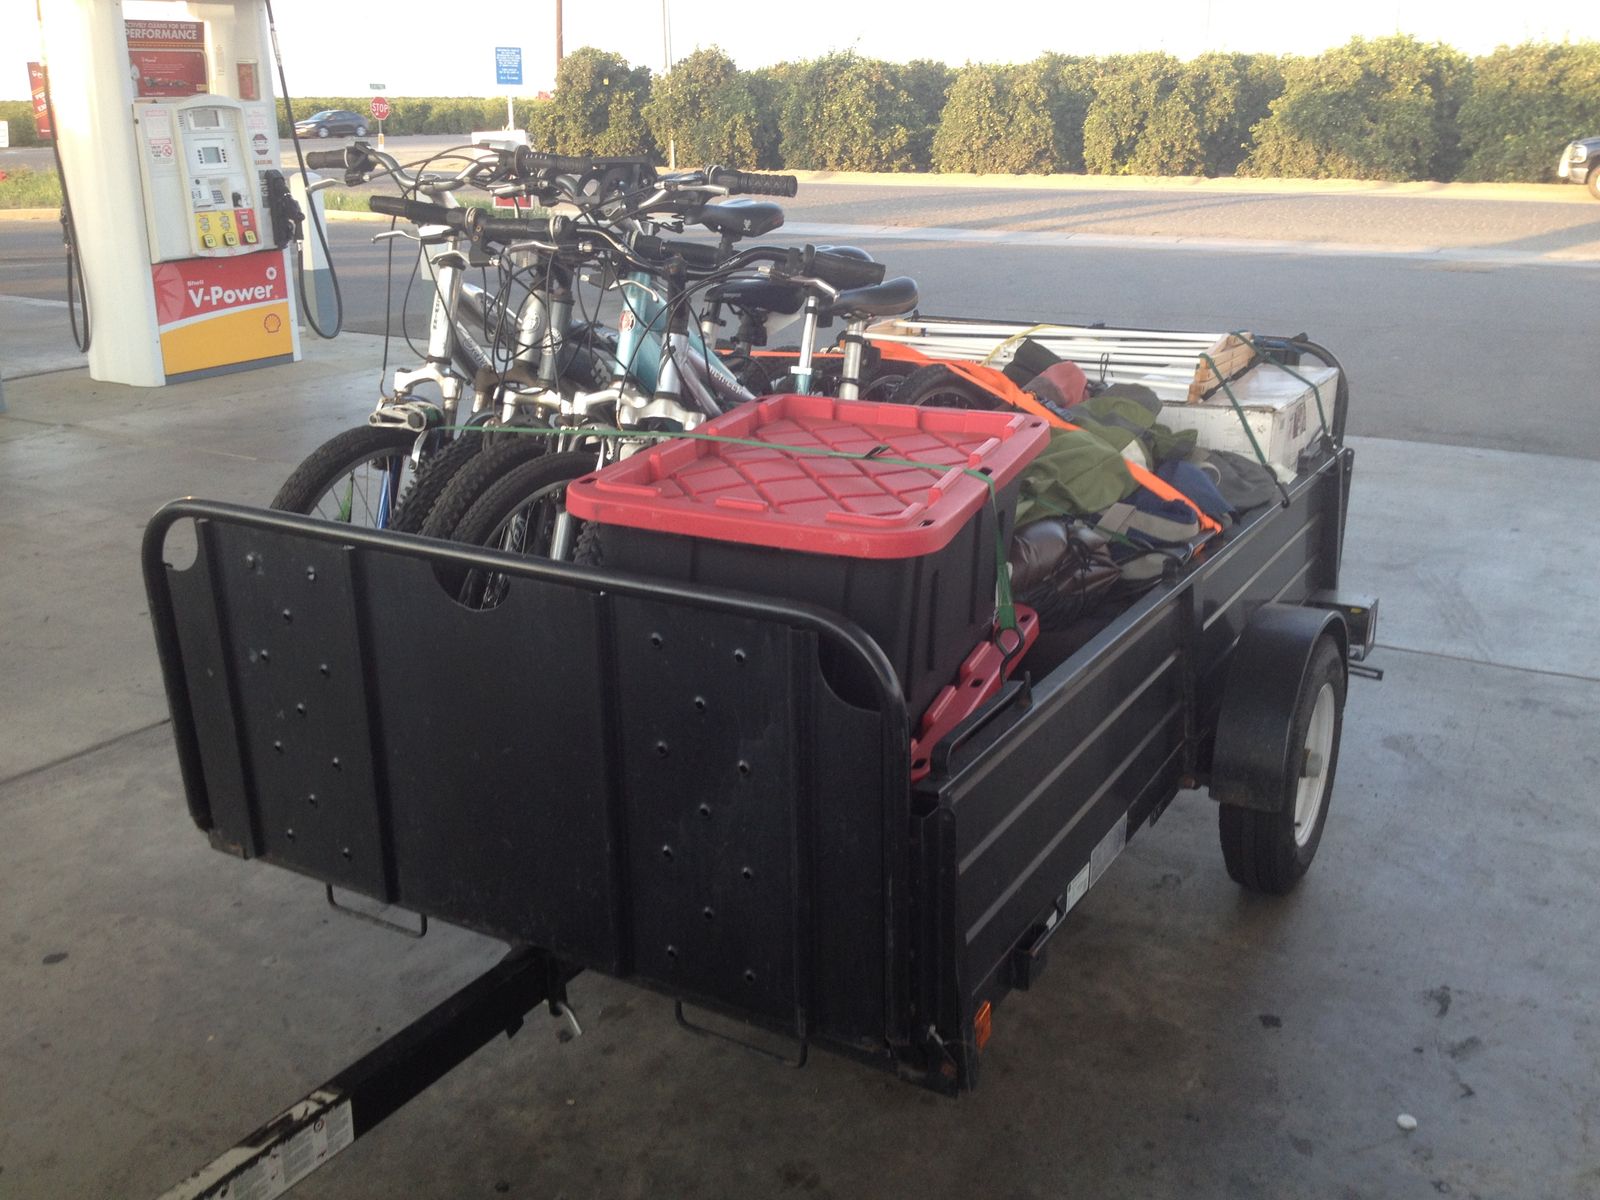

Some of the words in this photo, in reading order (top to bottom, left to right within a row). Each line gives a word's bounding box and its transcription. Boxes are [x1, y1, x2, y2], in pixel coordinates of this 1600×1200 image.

[125, 29, 198, 40] PERFORMANCE
[372, 103, 388, 113] STOP
[188, 284, 273, 308] V-Power
